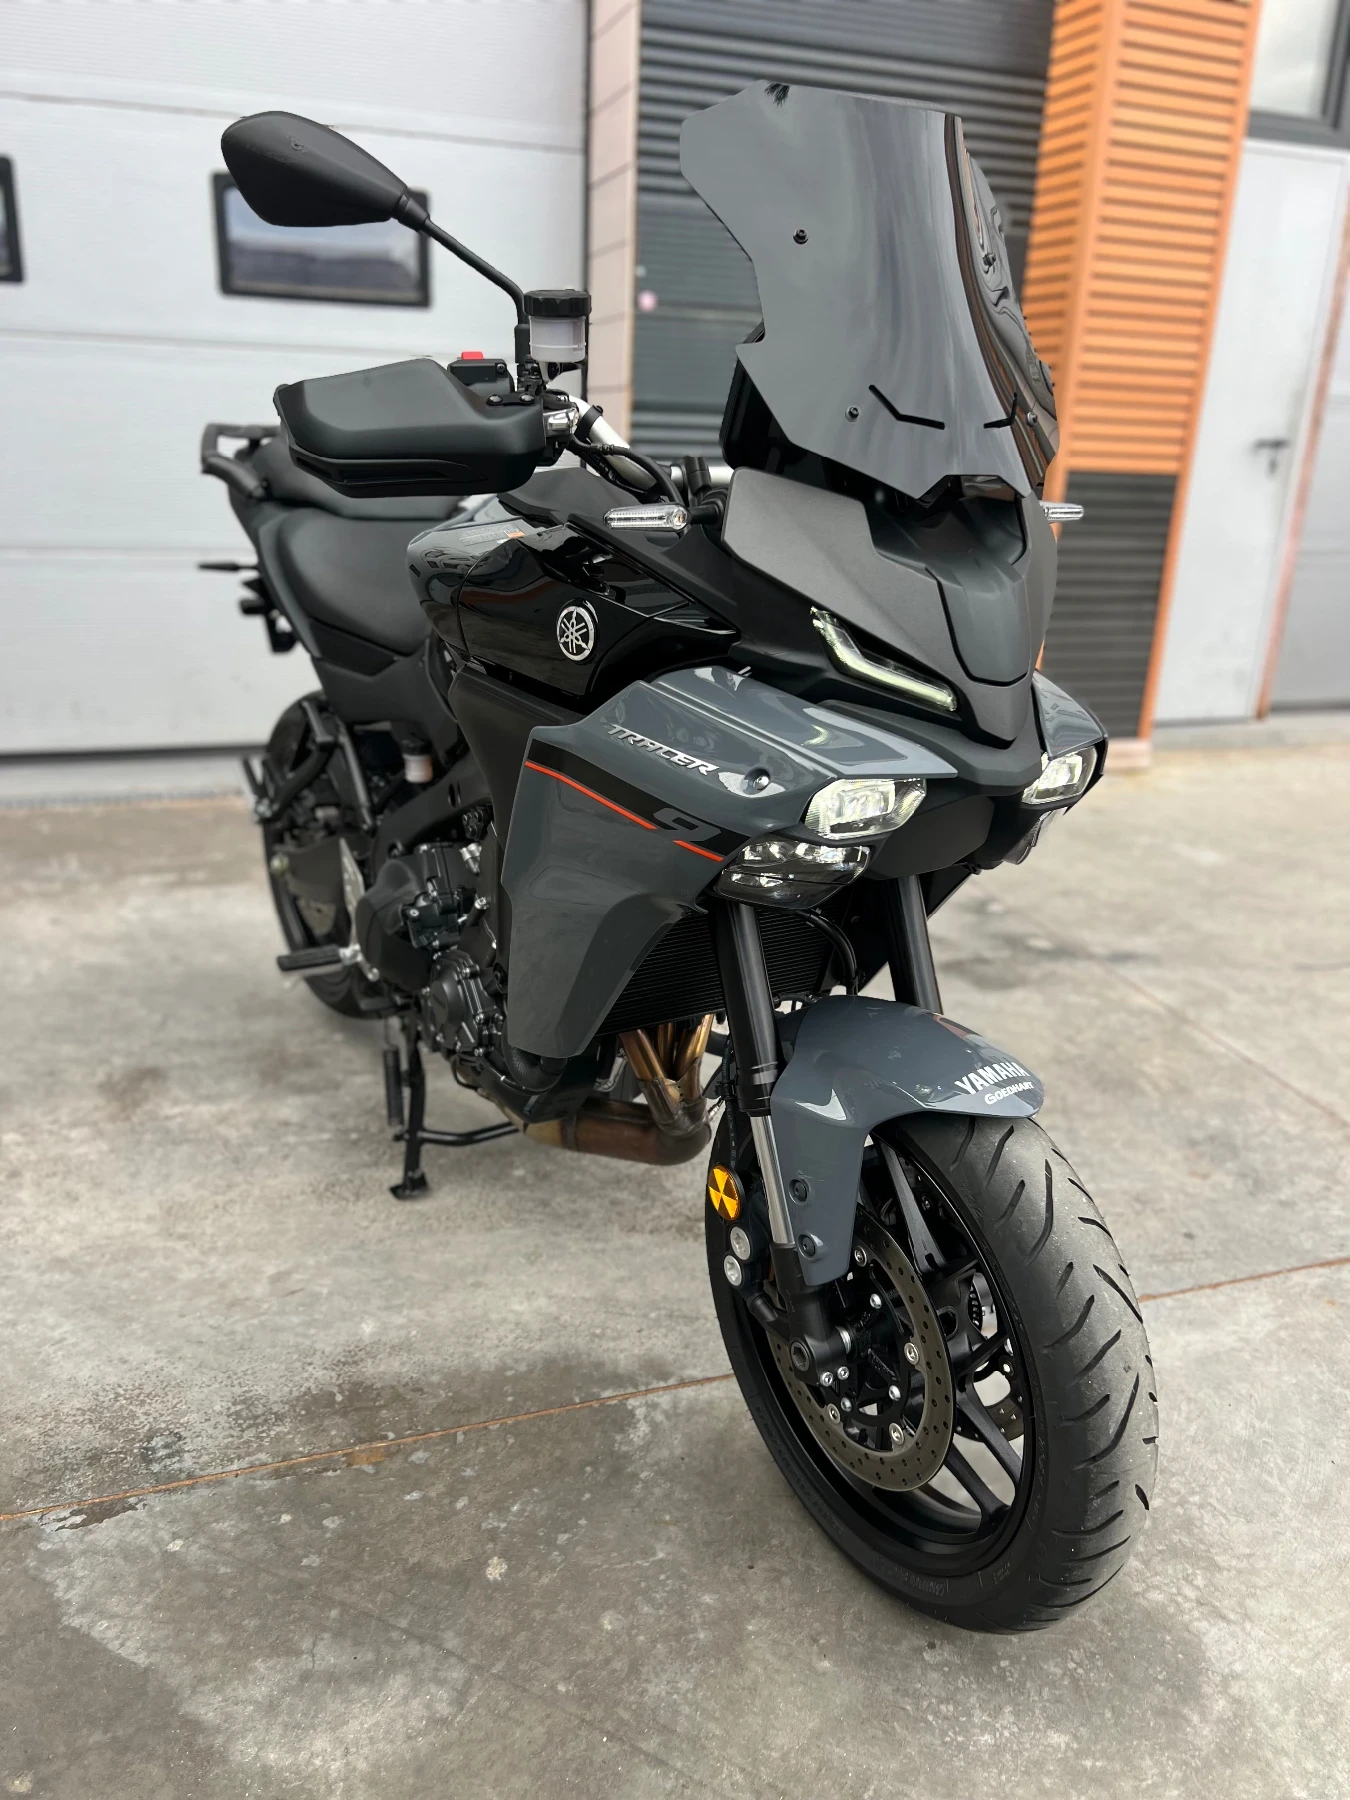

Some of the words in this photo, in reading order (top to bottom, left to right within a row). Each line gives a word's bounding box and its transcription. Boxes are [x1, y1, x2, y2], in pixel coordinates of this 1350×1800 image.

[606, 724, 720, 776] TRACER
[954, 1061, 1031, 1095] YAMAHA
[984, 1081, 1035, 1105] GOEDHART
